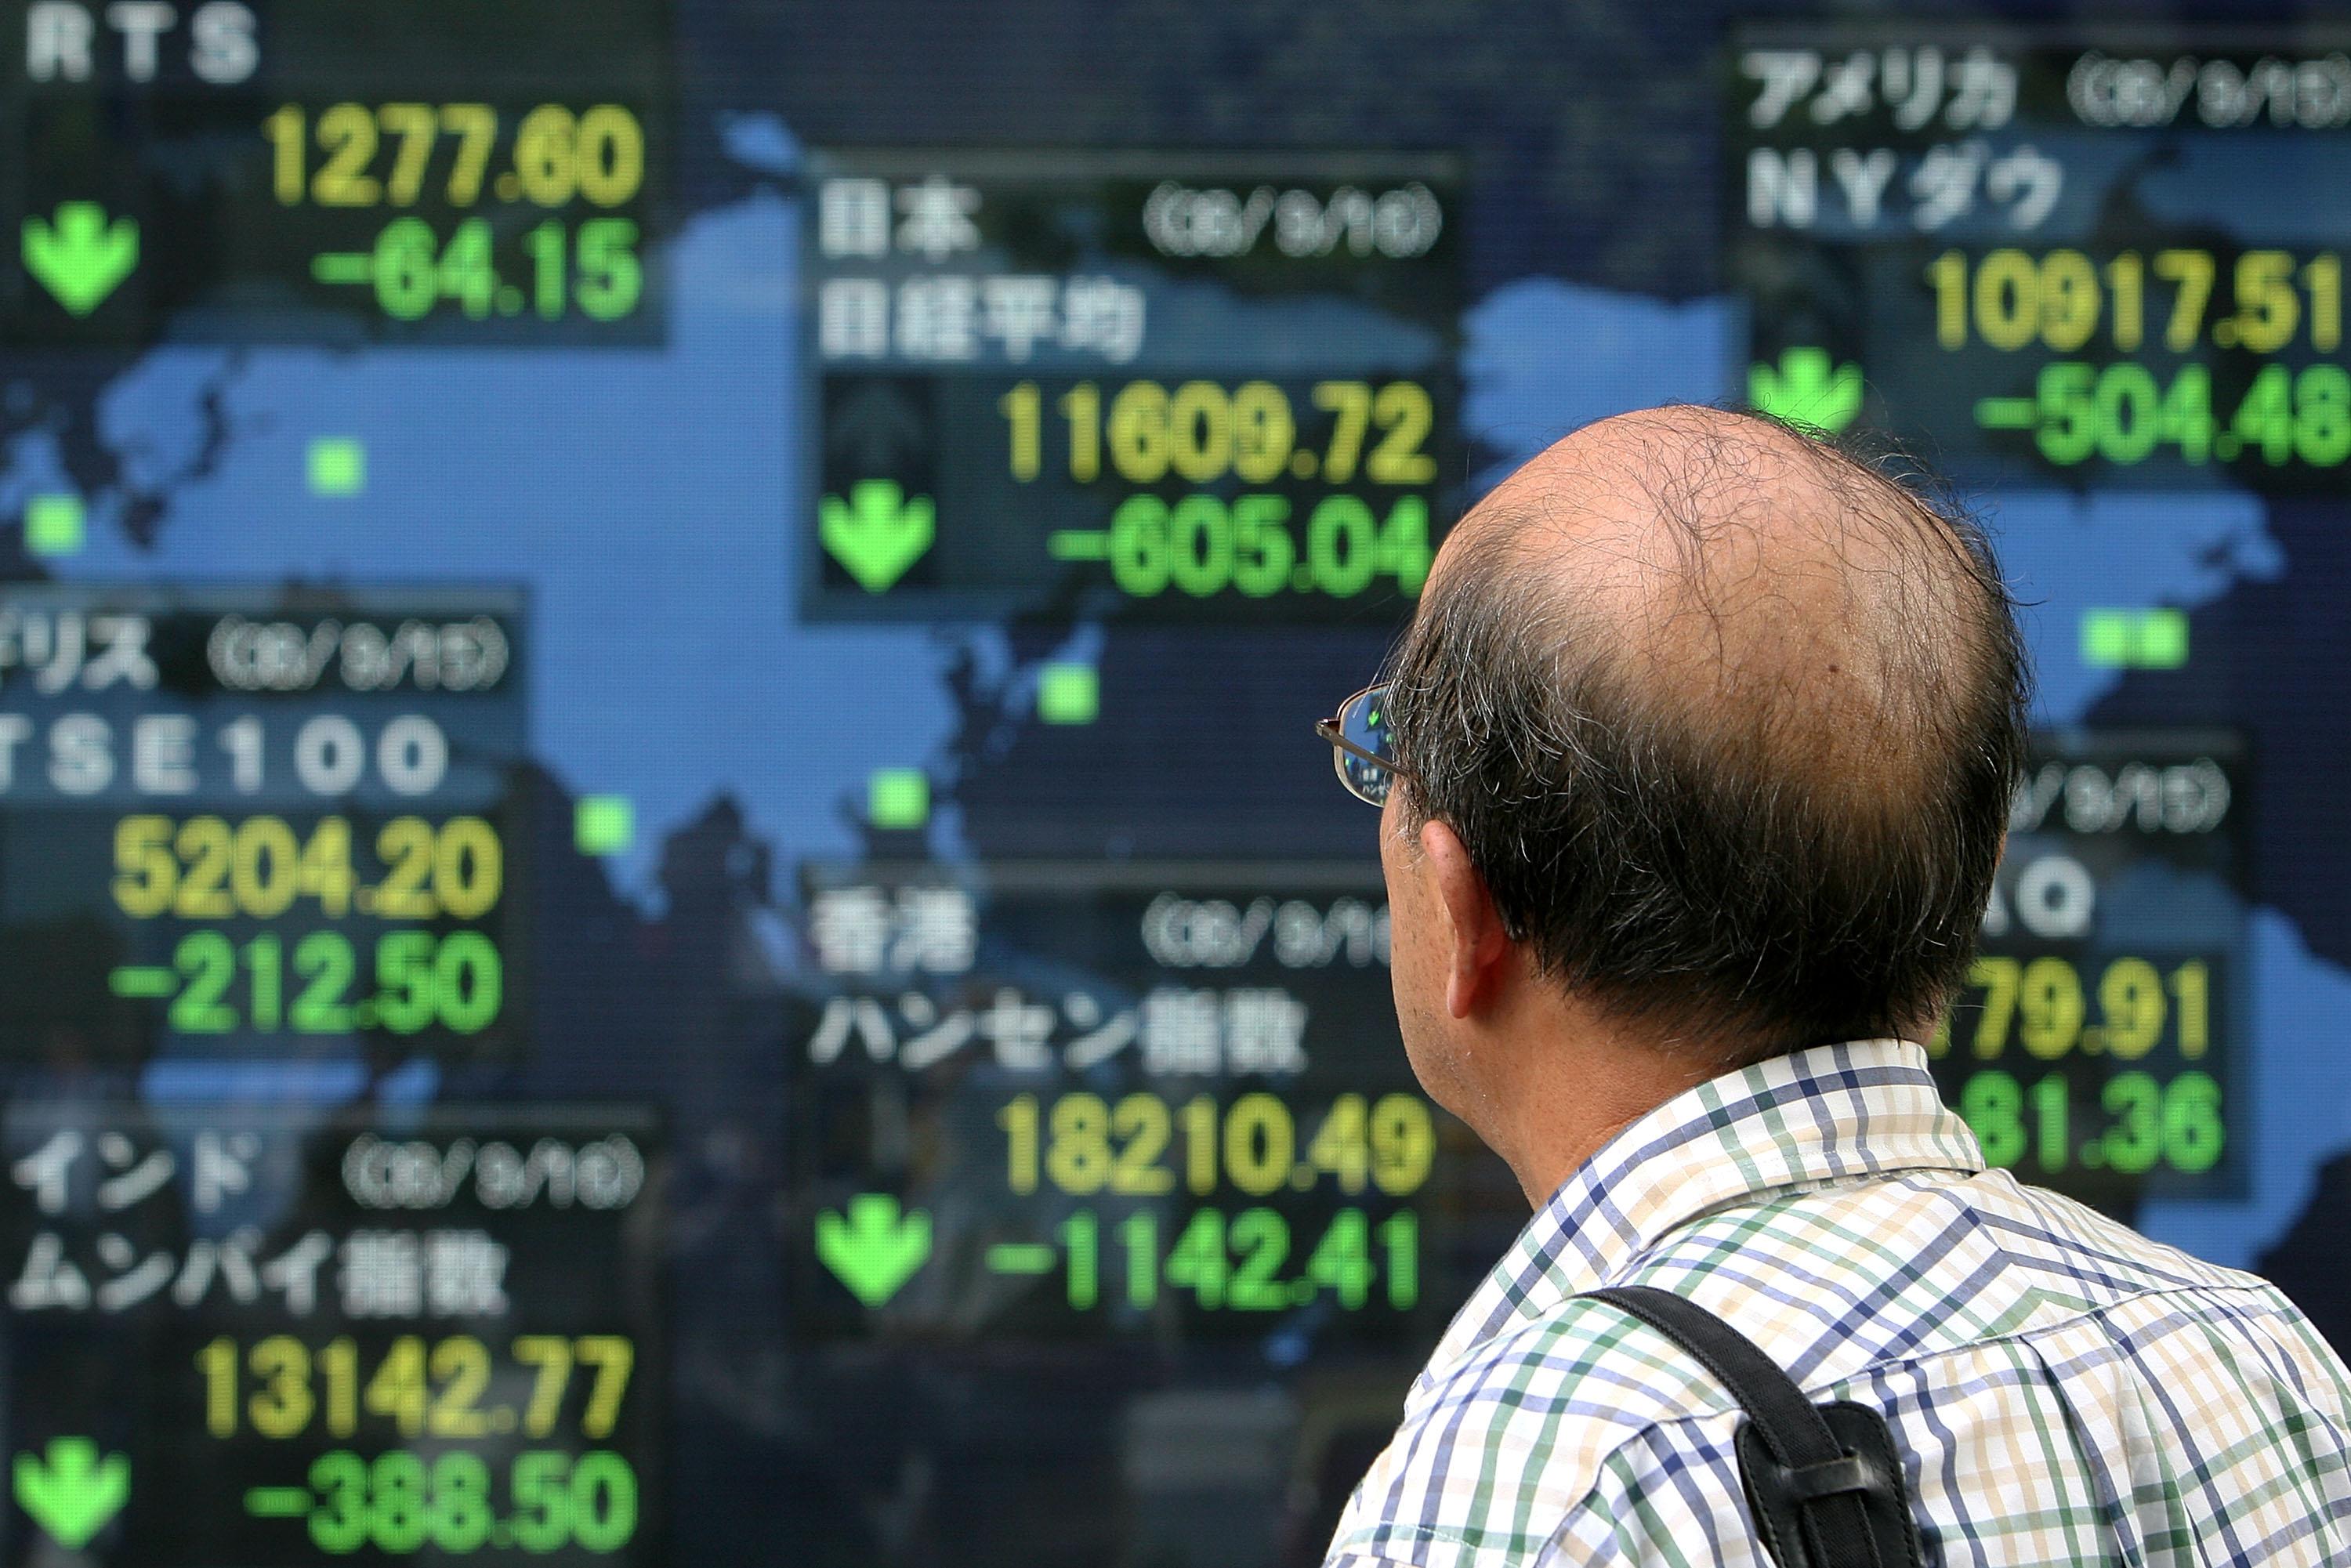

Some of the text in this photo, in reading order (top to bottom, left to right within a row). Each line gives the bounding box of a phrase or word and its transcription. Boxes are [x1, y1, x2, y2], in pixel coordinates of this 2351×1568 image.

[26, 2, 259, 83] RTS
[1744, 47, 2016, 129] アメリカ
[263, 103, 644, 207] 1277.60
[1747, 141, 2062, 229] NYダウ
[311, 216, 644, 320] -64.15
[820, 177, 980, 260] 日本
[820, 275, 1145, 363] 日経平均
[1926, 248, 2342, 353] 10917.51
[999, 381, 1437, 483] 11609.72
[1974, 363, 2351, 466] -504.48
[1048, 494, 1433, 598] -605.04
[112, 816, 502, 918] 5204.20
[811, 886, 976, 972] 香港
[109, 930, 502, 1034] -212.50
[810, 987, 1307, 1074] ハンセン指数
[1928, 957, 2208, 1059] 79.91
[13, 1132, 259, 1212] インド
[998, 1093, 1436, 1195] 18210.49
[11, 1229, 510, 1317] ムンバイ指数
[985, 1208, 1418, 1311] -1142.41
[195, 1334, 633, 1439] 13142.77
[243, 1450, 639, 1553] -388.50
